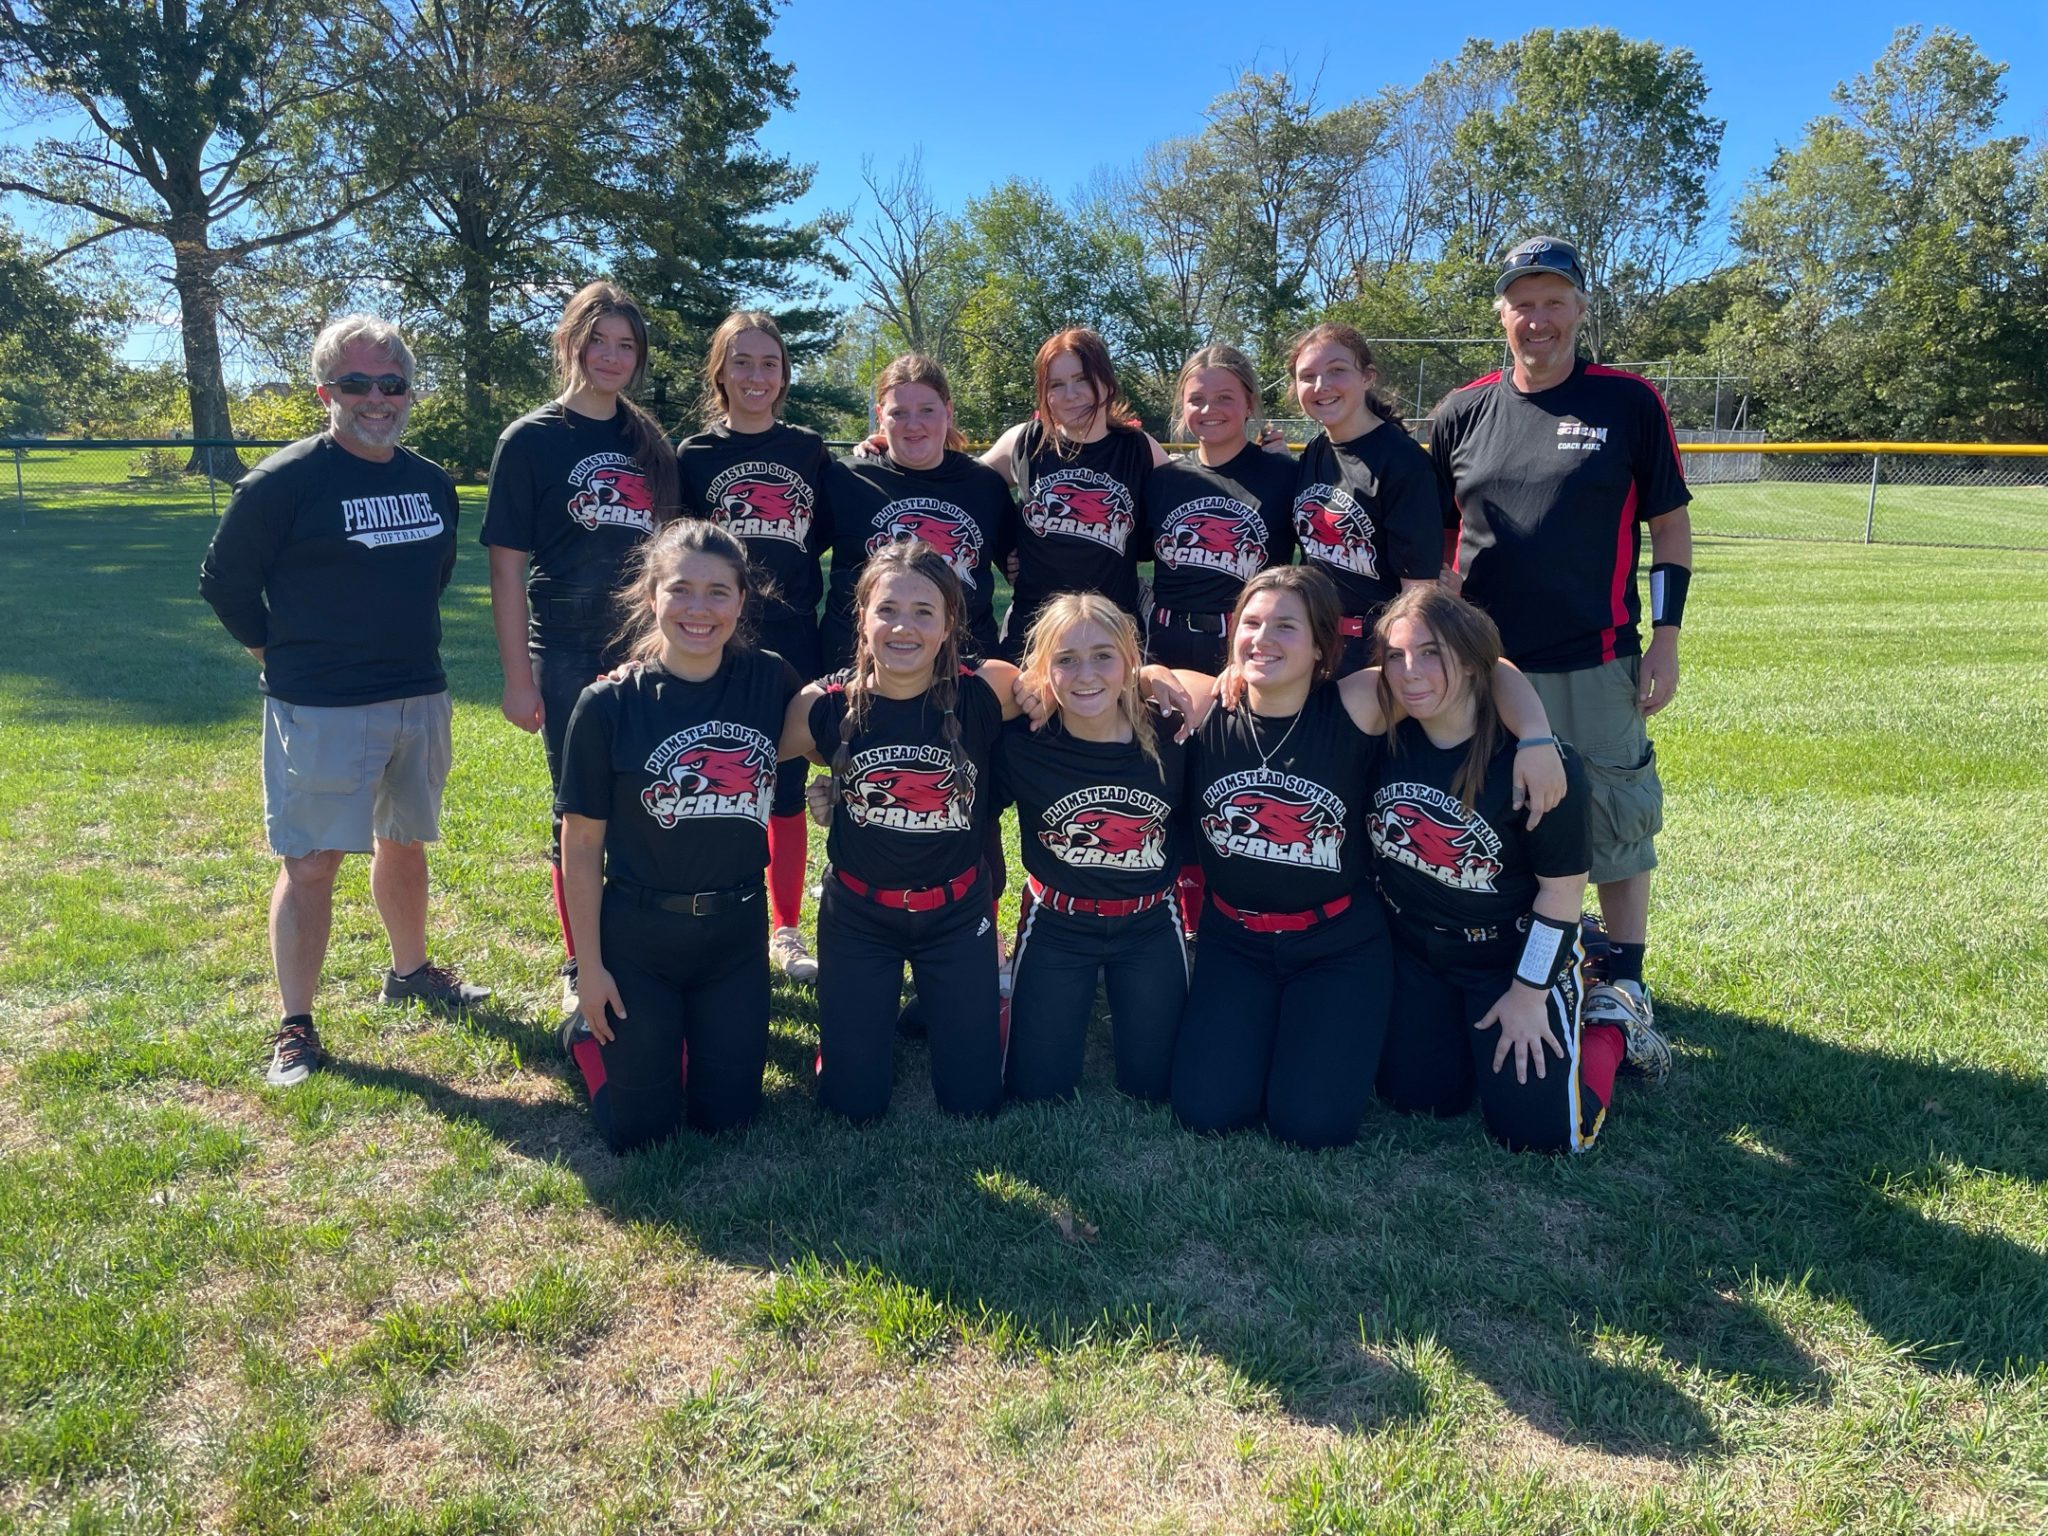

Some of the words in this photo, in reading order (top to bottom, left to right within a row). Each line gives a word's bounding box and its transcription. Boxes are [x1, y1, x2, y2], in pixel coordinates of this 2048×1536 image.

[1557, 427, 1608, 443] SCREAM
[1582, 443, 1601, 451] MIKE
[568, 452, 627, 487] PLUMSTEAD
[706, 461, 767, 504] PLUMSTEAD
[768, 462, 814, 508] SOFTBALL
[341, 492, 438, 531] PENNRIDGE
[577, 504, 655, 533] SCREA
[871, 498, 940, 529] PLUMSTEAD
[940, 501, 984, 549] SOFTBALL
[1161, 496, 1226, 530] PLUMSTEAD
[1225, 499, 1269, 544] SOFTBALL
[1331, 488, 1375, 539] SOFTBALL
[373, 529, 430, 545] SOFTBALL
[1028, 513, 1131, 554] SCREAM
[1160, 545, 1261, 582] SCREAM
[644, 720, 721, 775] PLUMSTEAD
[652, 790, 773, 826] SCREAM
[1042, 786, 1128, 827] PLUMSTEAD
[1203, 769, 1284, 808] PLUMSTEAD
[1284, 775, 1347, 823] SOFTBALL
[1051, 840, 1166, 869] SCREAM
[1210, 829, 1339, 869] SCREAM
